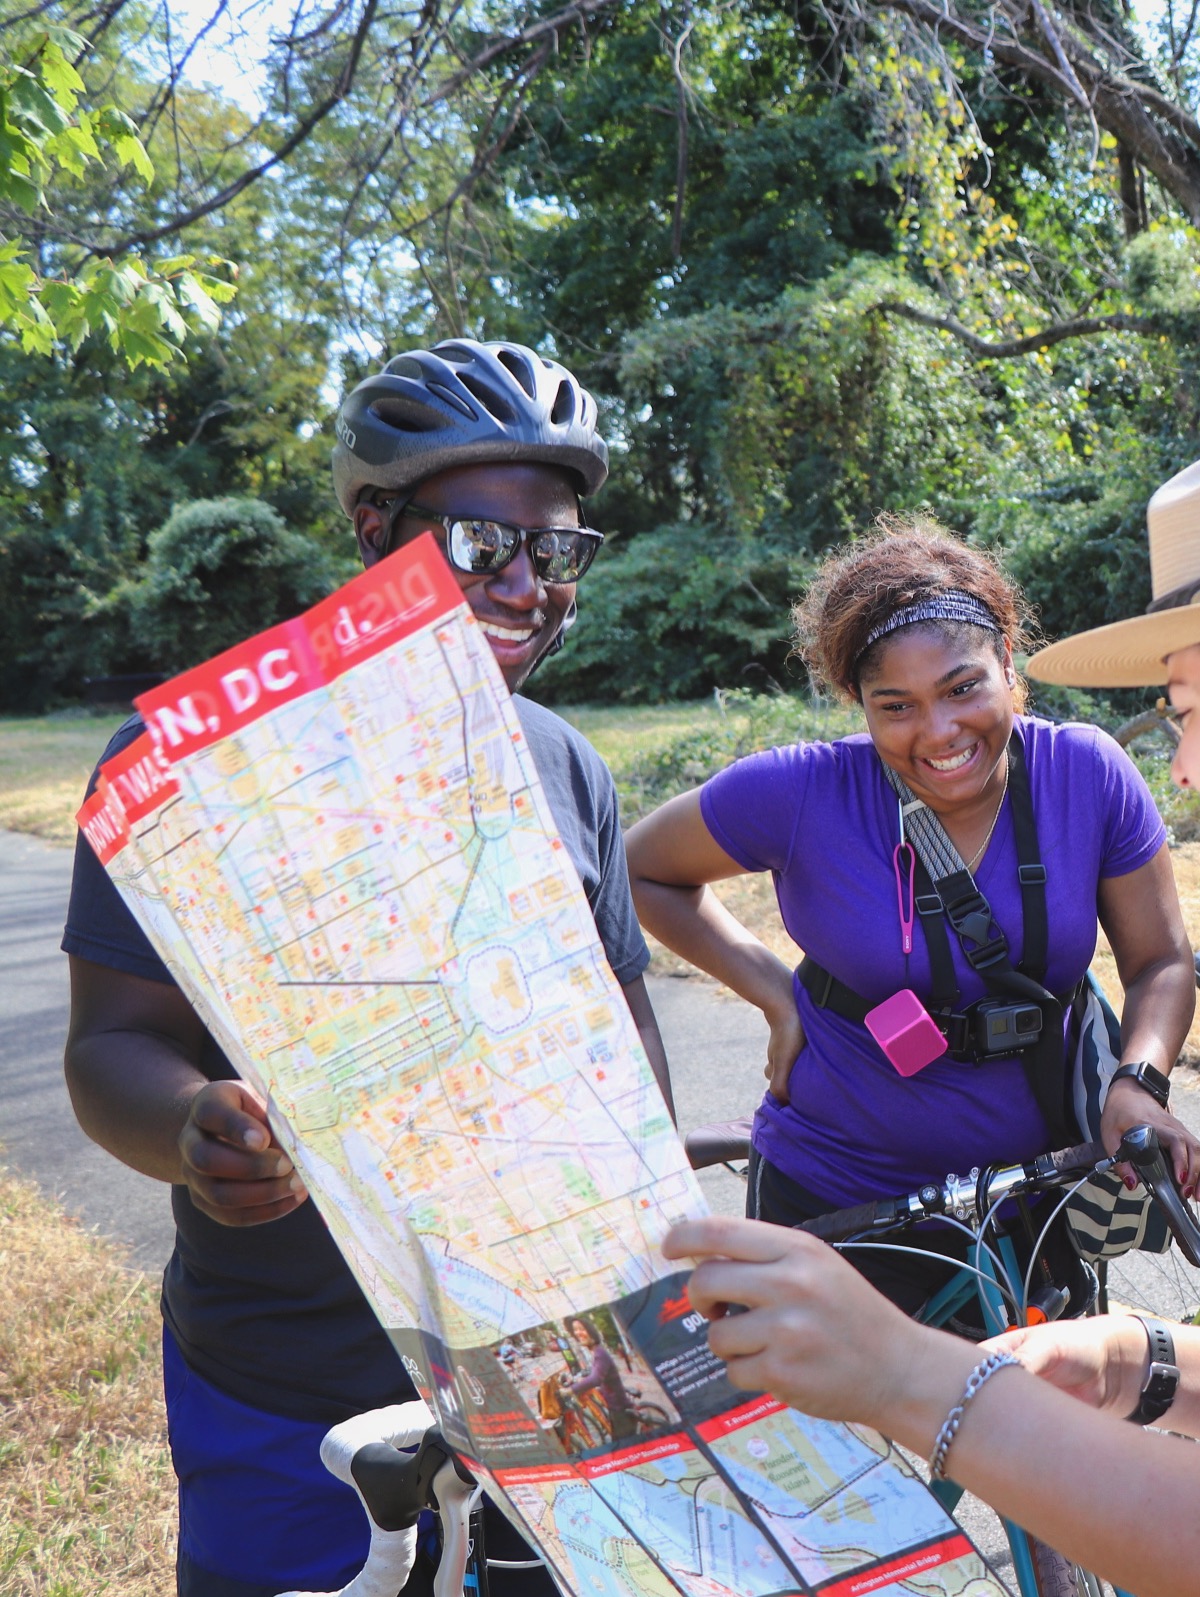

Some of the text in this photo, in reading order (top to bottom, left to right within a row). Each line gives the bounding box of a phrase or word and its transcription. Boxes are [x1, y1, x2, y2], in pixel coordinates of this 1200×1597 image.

[221, 648, 299, 714] DC
[683, 1348, 697, 1358] your
[673, 1383, 695, 1398] Explore
[696, 1377, 708, 1387] your
[732, 1404, 767, 1425] Roosevelt
[591, 1462, 612, 1475] George
[660, 1441, 680, 1454] Bridge
[850, 1552, 942, 1594] Arlington Memorial Bridge
